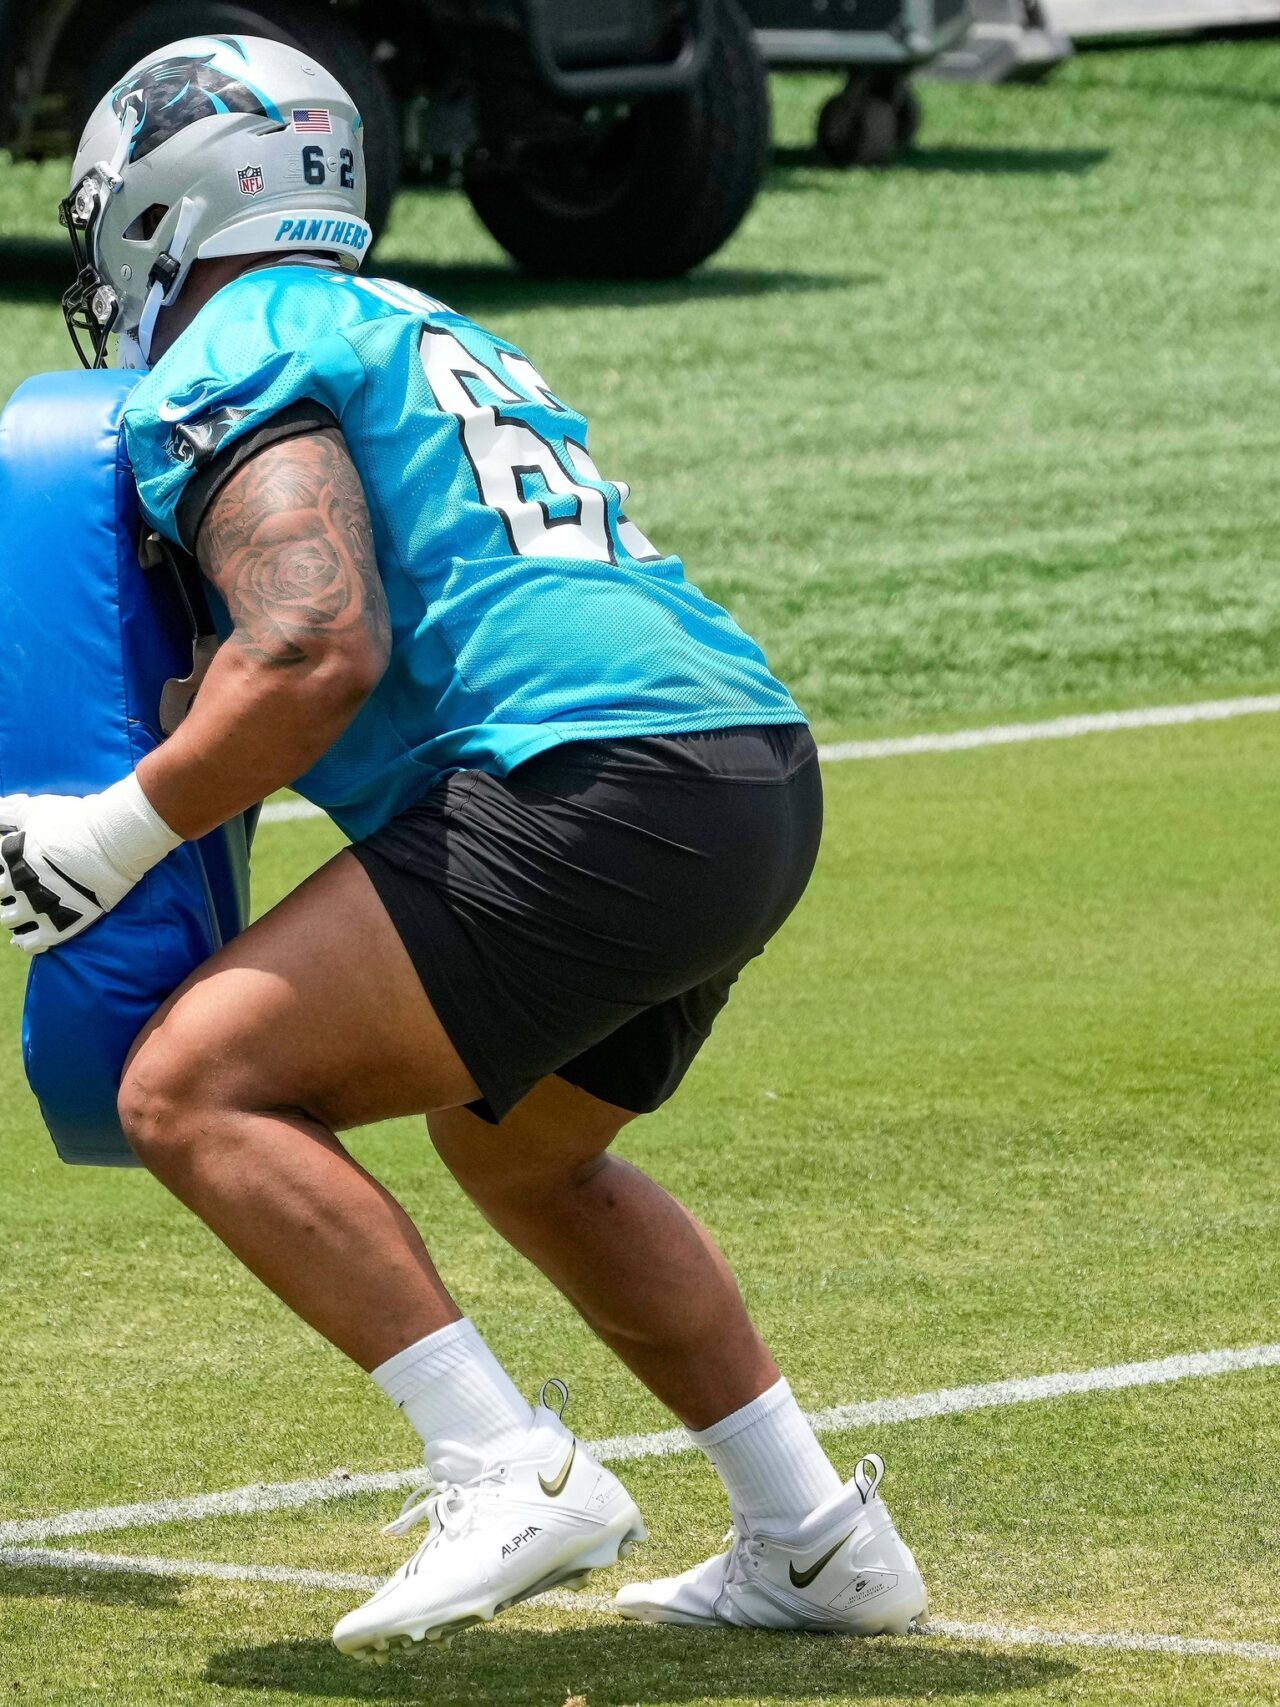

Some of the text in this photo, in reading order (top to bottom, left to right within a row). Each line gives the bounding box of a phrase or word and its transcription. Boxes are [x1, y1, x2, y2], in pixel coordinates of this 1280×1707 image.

[241, 177, 263, 194] NFL
[274, 219, 368, 250] PANTHERS
[500, 1526, 543, 1559] ALPHA
